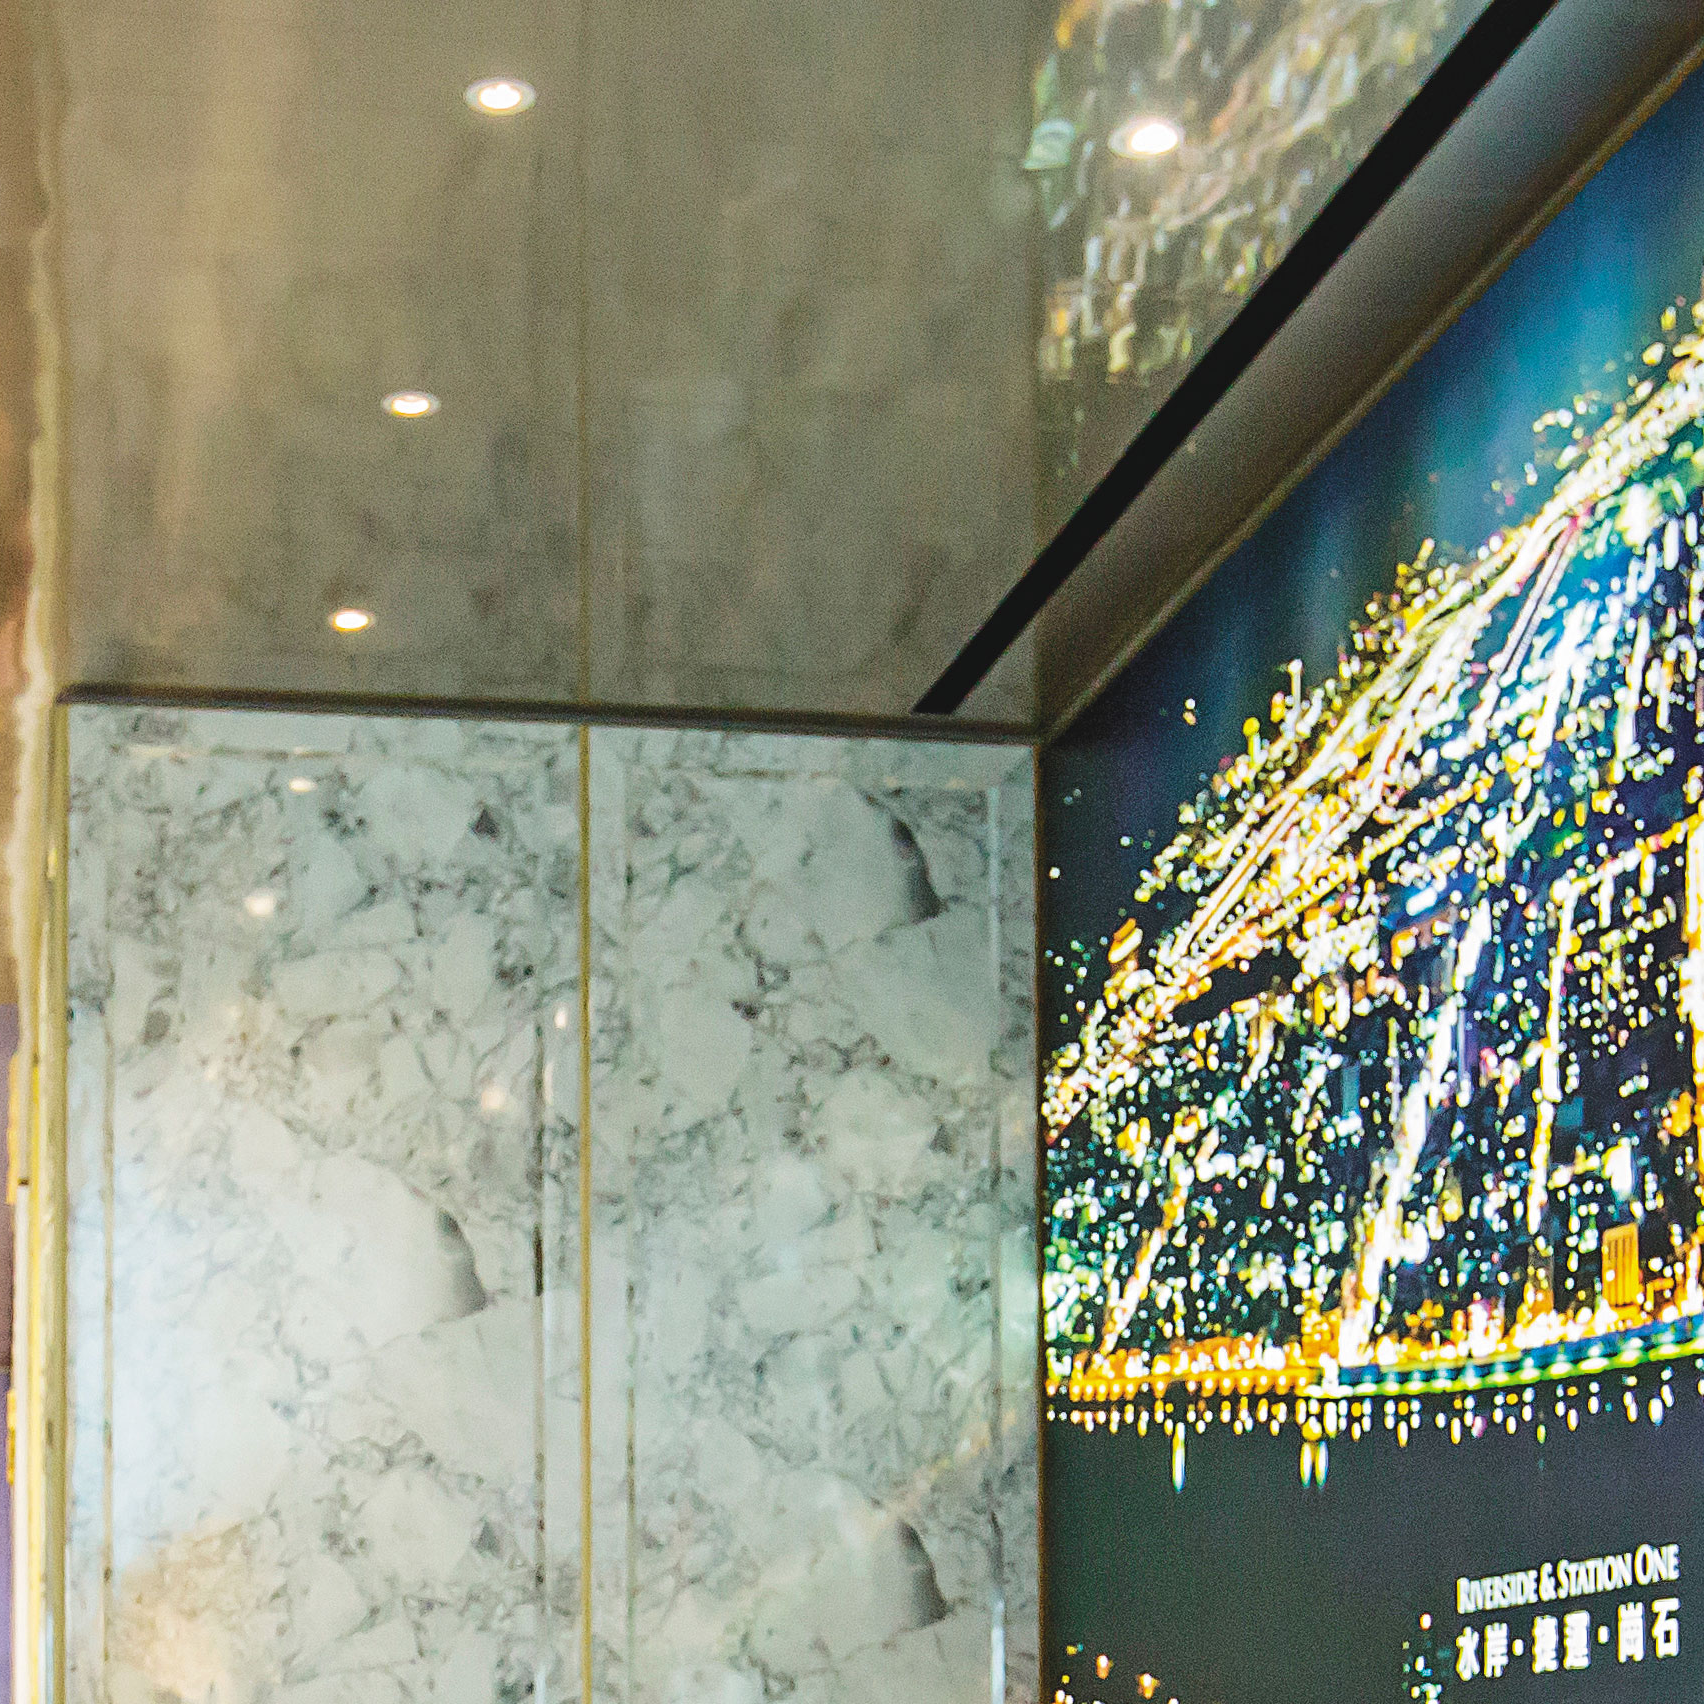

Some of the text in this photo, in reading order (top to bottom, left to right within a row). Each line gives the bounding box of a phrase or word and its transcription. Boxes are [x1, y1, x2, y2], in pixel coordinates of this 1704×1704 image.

[1456, 1543, 1681, 1614] RIVERSIDE & STATION ONE
